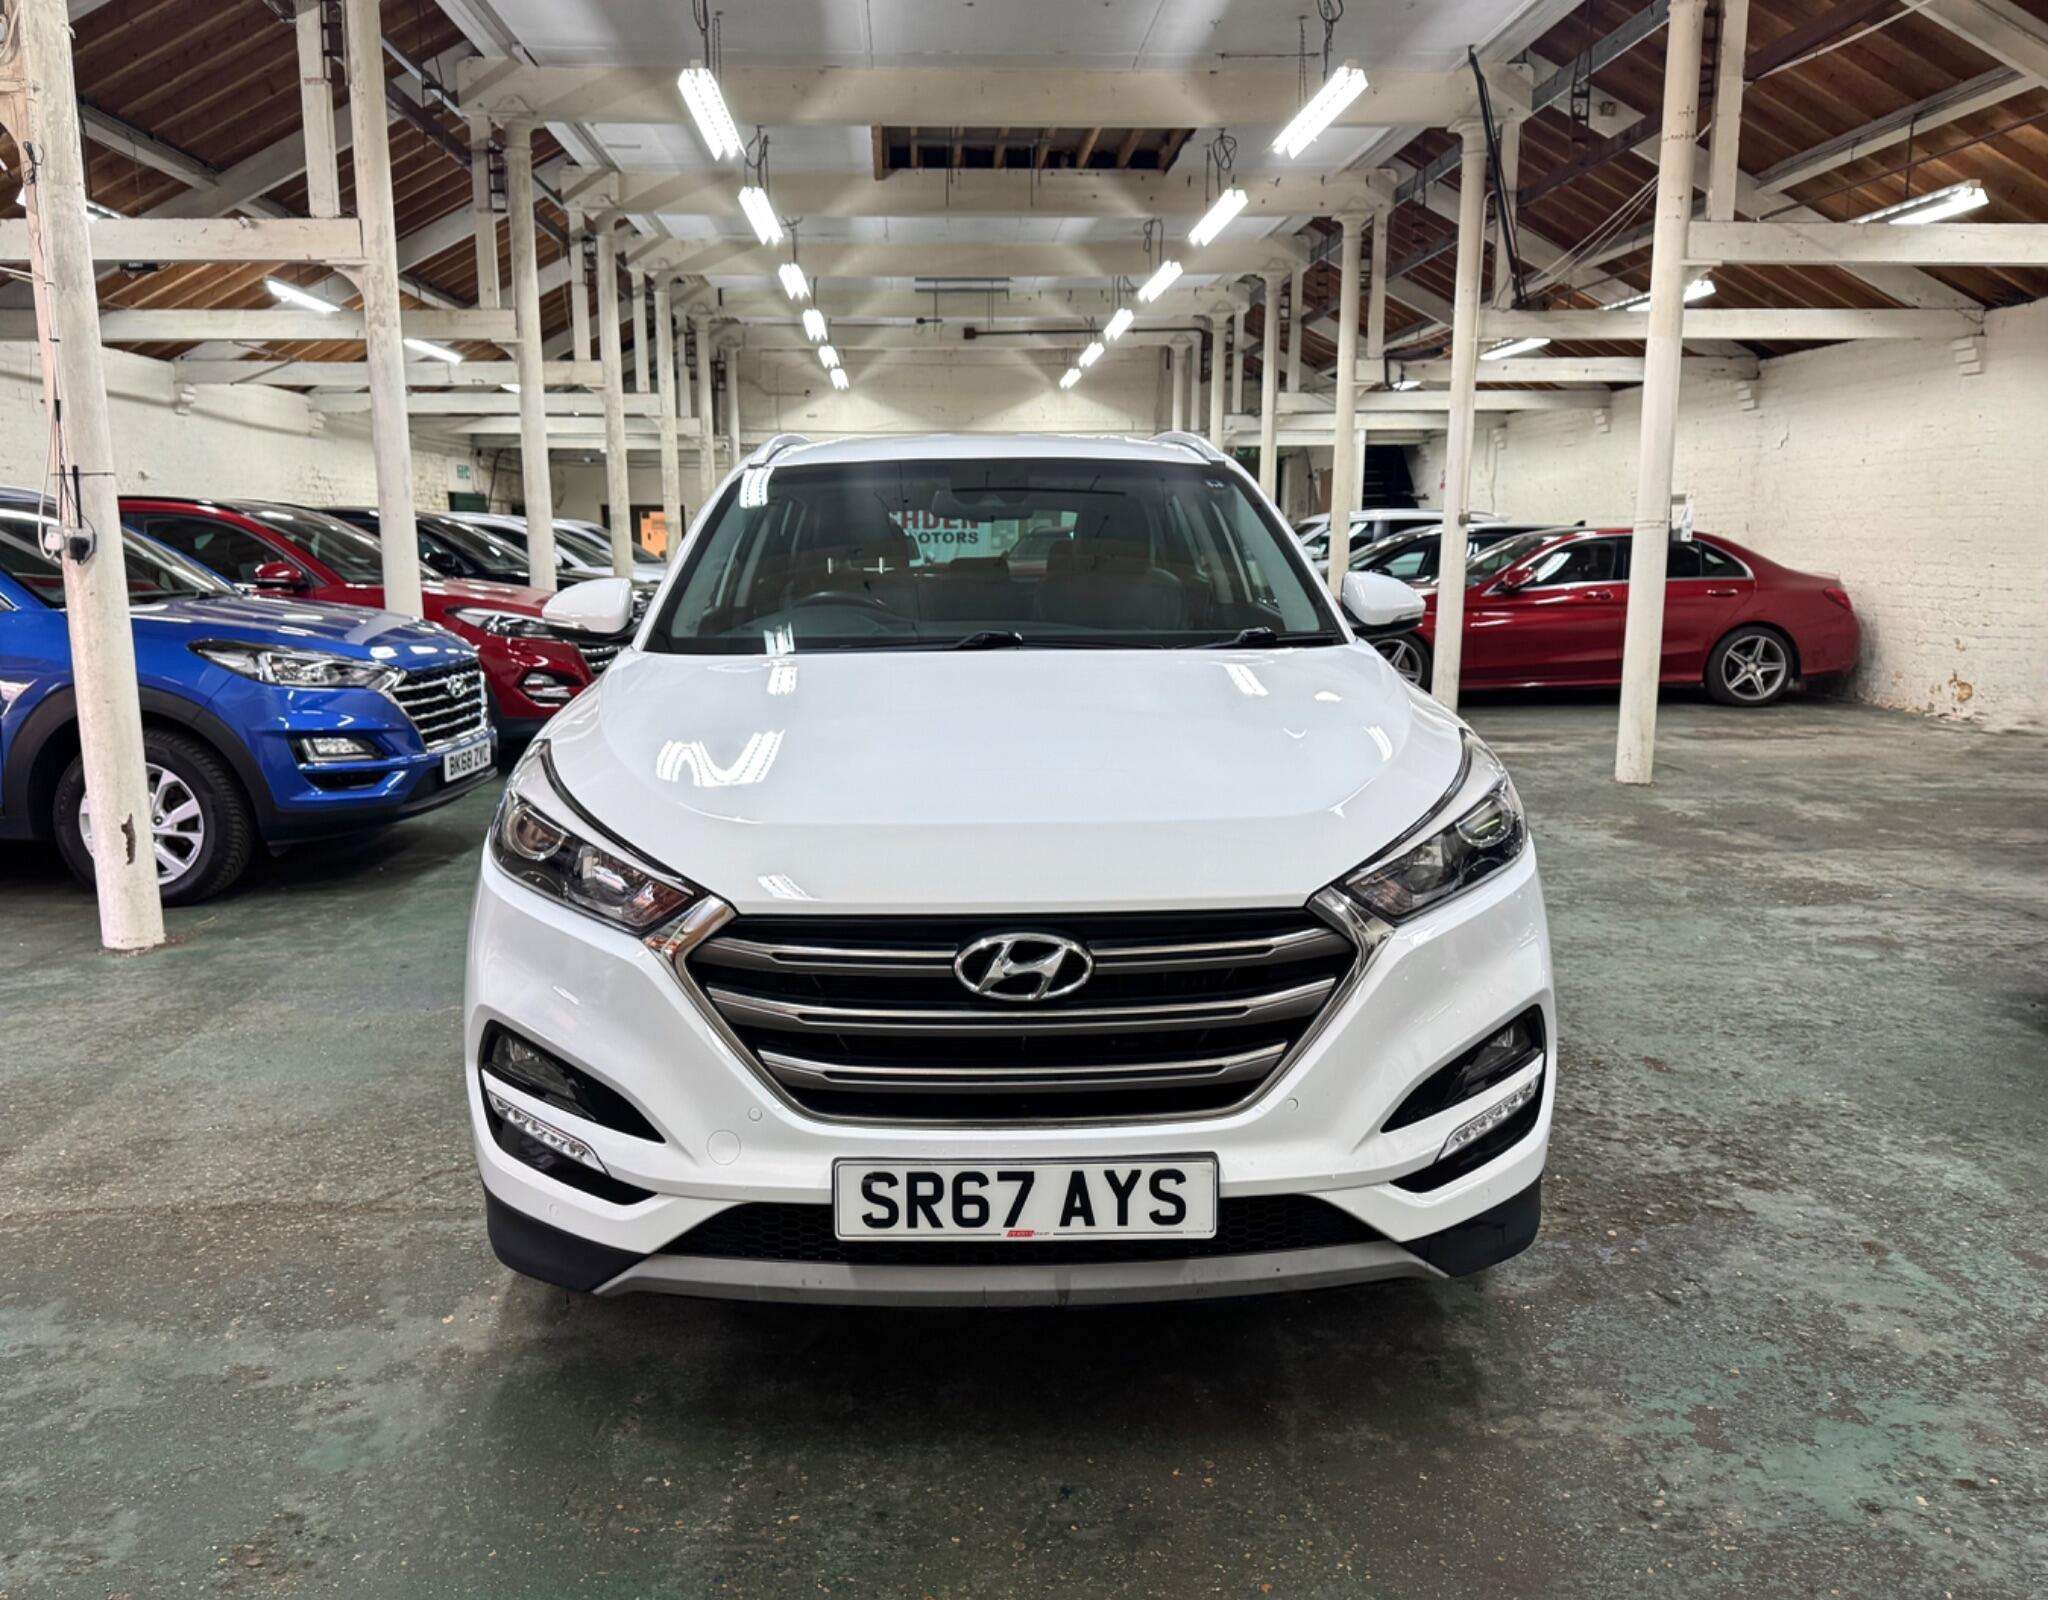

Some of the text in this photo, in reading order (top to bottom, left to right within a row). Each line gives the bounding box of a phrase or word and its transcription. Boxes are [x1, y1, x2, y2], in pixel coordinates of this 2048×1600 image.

[917, 531, 979, 544] OTORS
[861, 1168, 1187, 1229] SR67 AYS
